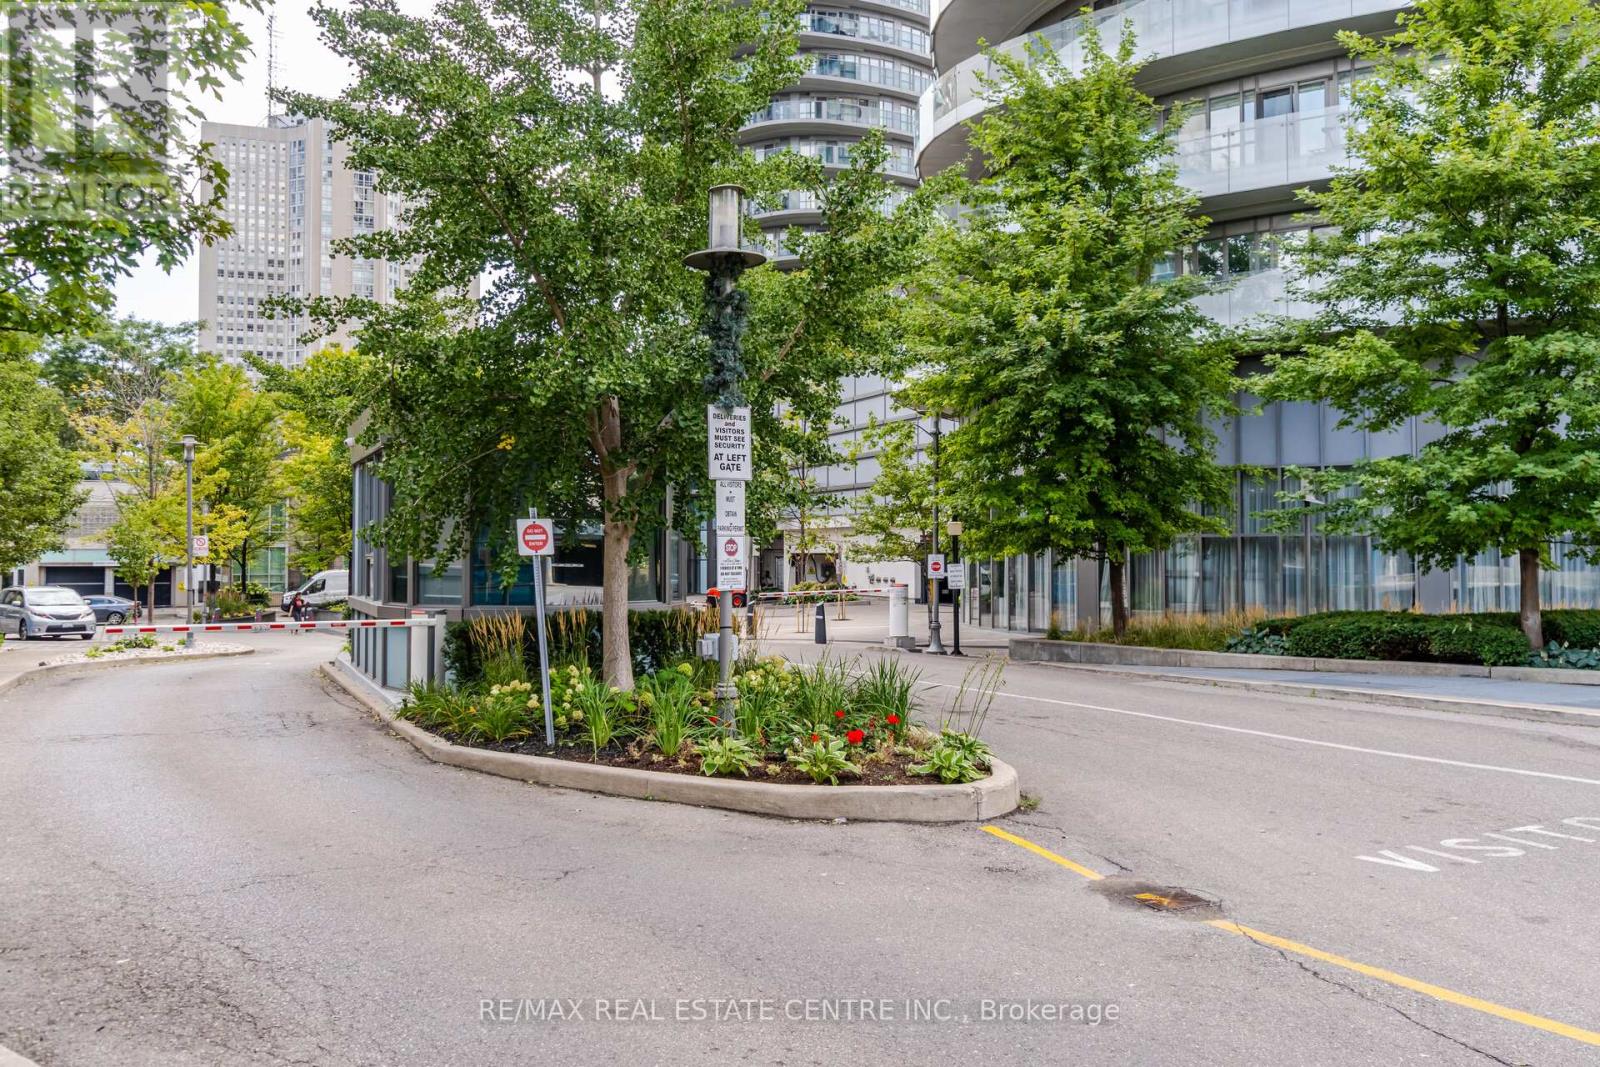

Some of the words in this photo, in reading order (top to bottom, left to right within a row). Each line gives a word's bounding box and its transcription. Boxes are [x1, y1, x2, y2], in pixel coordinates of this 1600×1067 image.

[712, 413, 746, 421] DELIVERIES
[714, 442, 745, 450] SECURITY
[713, 453, 724, 461] AT
[727, 454, 746, 462] LEFT
[719, 462, 742, 472] GATE
[725, 543, 738, 552] STOP
